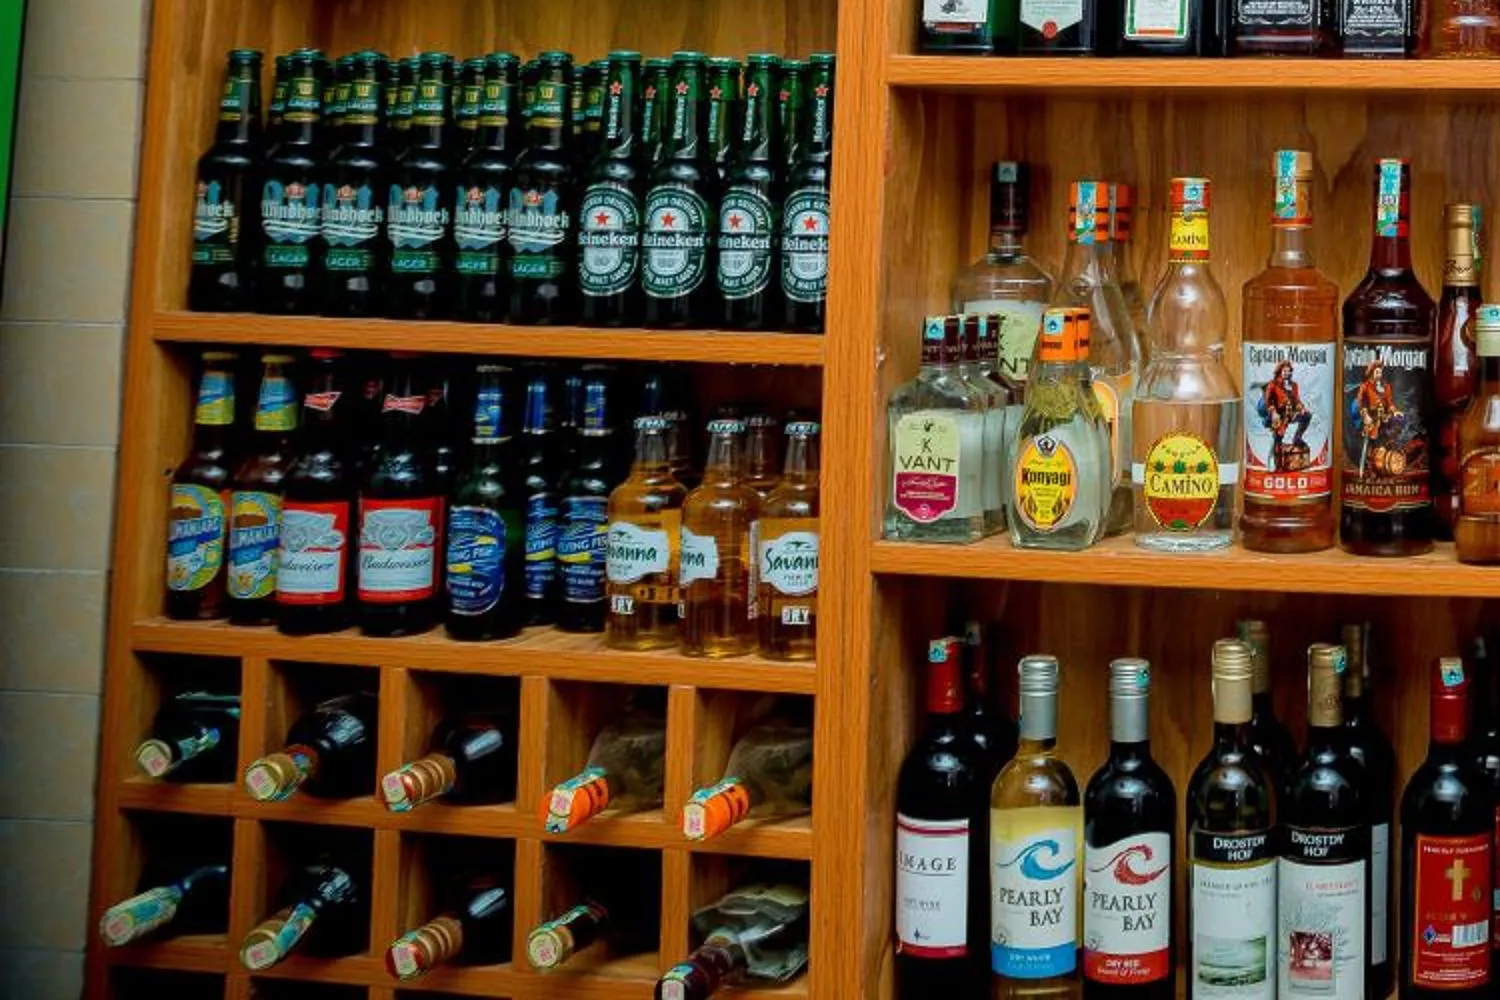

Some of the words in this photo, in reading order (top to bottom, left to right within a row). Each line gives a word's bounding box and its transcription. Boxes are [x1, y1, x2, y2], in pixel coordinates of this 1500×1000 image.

[261, 199, 323, 223] Windhoe
[1249, 345, 1286, 367] Captain
[1286, 345, 1328, 366] Morgan
[1375, 344, 1428, 370] Morgan
[899, 455, 956, 473] VANT
[1020, 467, 1072, 488] Konyagi
[1263, 476, 1308, 490] GOLD
[360, 556, 431, 573] Budweiser
[781, 604, 810, 625] DRY
[1212, 834, 1267, 850] DROSTDY
[1291, 830, 1346, 846] DROSTDY
[1227, 849, 1253, 862] HOF
[1303, 845, 1330, 858] HOF
[999, 886, 1065, 908] PEARLY
[1091, 890, 1158, 911] PEARLY
[1029, 906, 1065, 928] BAY
[1122, 910, 1157, 932] BAY
